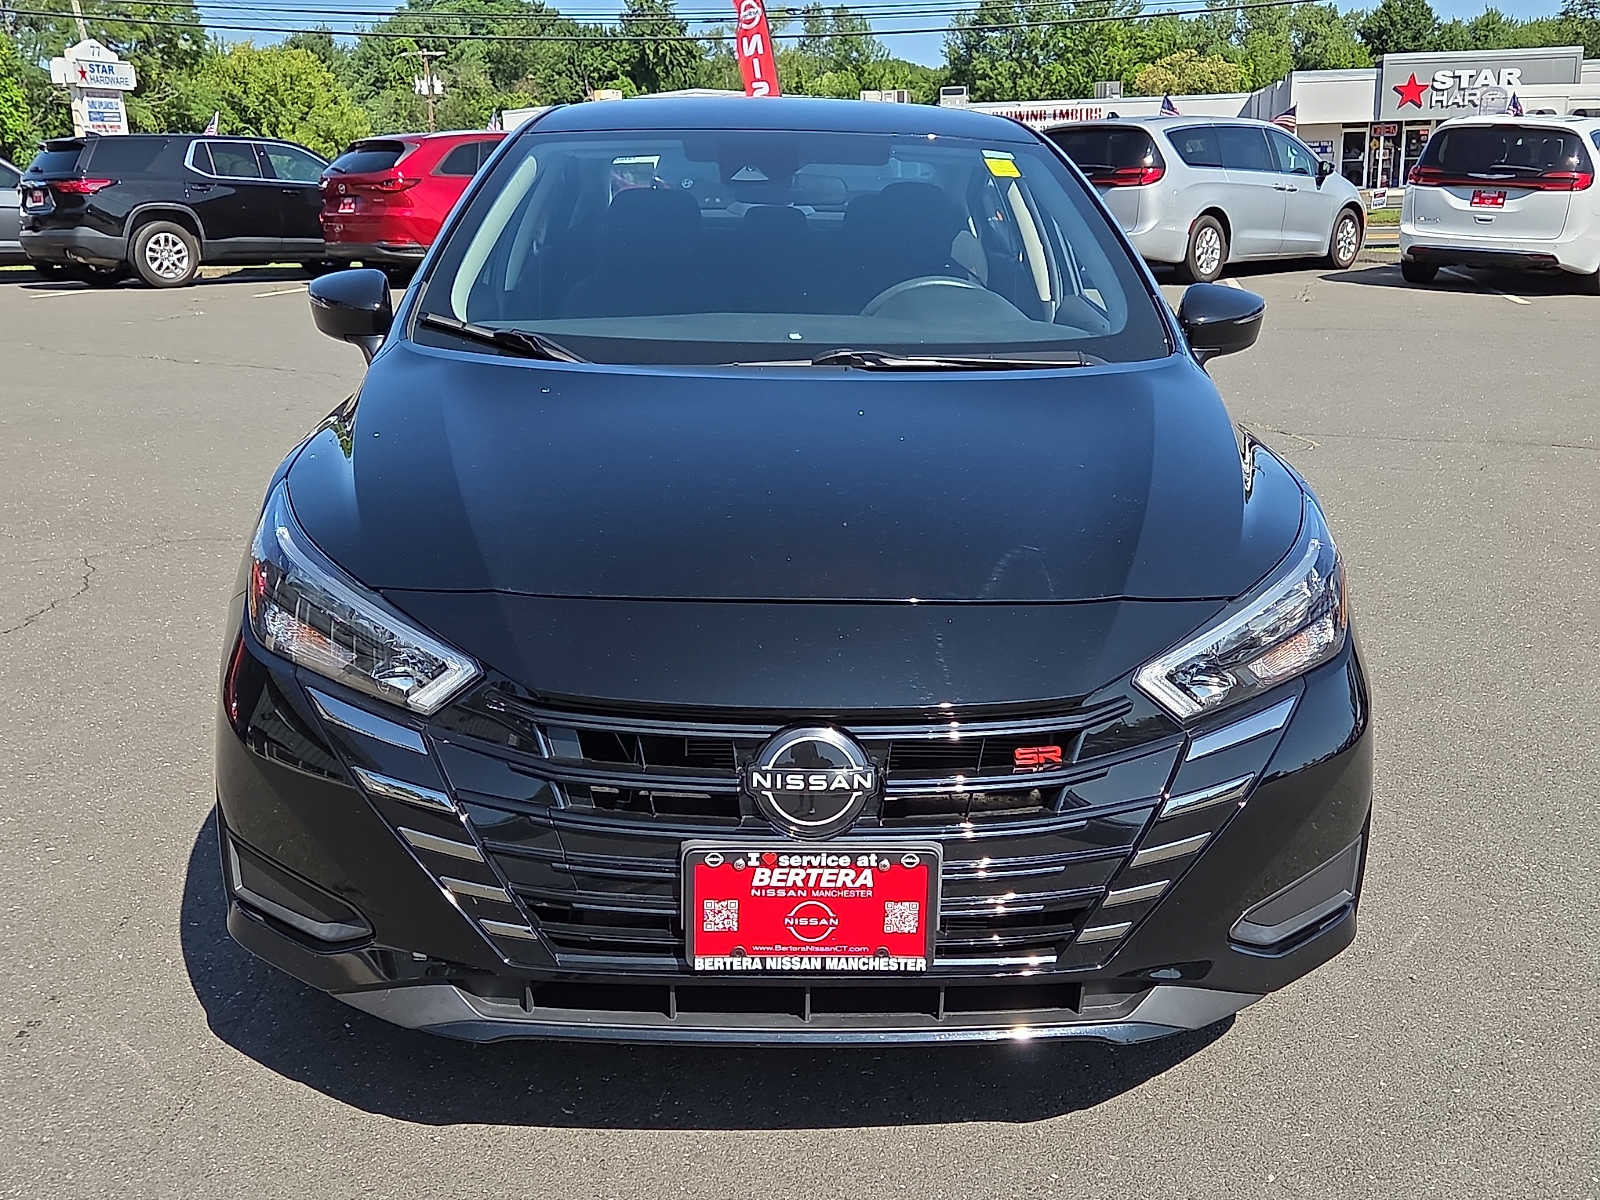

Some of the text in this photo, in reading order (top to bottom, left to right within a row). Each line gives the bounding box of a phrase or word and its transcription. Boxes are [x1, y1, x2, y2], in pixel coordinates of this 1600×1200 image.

[89, 45, 101, 57] 77
[88, 63, 115, 75] STAR
[89, 75, 129, 87] HARDWARE
[1430, 68, 1522, 92] STAR
[1053, 107, 1102, 121] EMBERS
[1014, 745, 1062, 765] SR
[752, 771, 872, 791] NISSAN
[747, 853, 878, 867] I service at
[751, 867, 874, 888] BERTERA
[750, 888, 873, 898] NISSAN MANCHESTER
[784, 917, 839, 926] NISSAN
[752, 944, 869, 953] www.BerteraNissanCT.com
[694, 957, 927, 972] BERTERA NISSAN MANCHESTER
